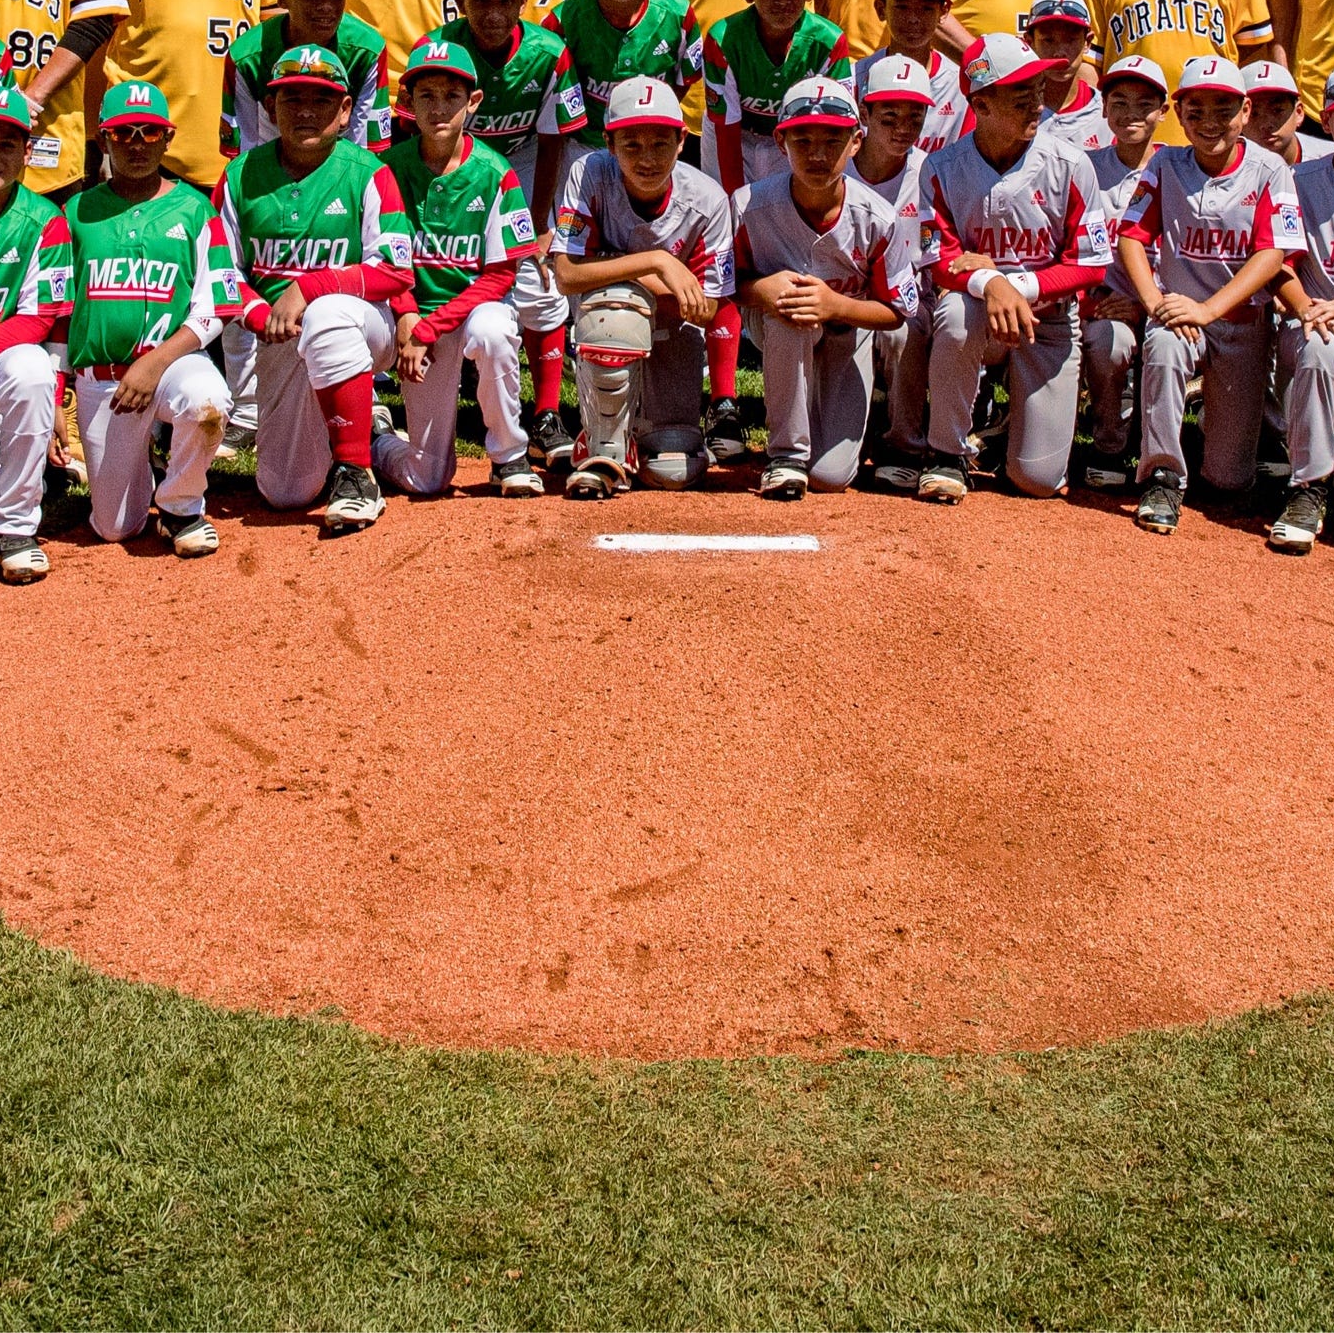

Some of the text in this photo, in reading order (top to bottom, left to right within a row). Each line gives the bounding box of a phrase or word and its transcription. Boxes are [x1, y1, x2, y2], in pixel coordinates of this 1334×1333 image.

[8, 29, 58, 69] 86
[428, 41, 448, 59] M
[1128, 57, 1142, 68] J
[1204, 61, 1217, 75] J
[1257, 64, 1271, 78] J
[897, 63, 911, 81] J
[129, 85, 151, 103] M
[640, 85, 654, 106] J
[975, 226, 1053, 260] JAPAN
[249, 237, 349, 269] MEXICO
[88, 258, 179, 292] MEXICO
